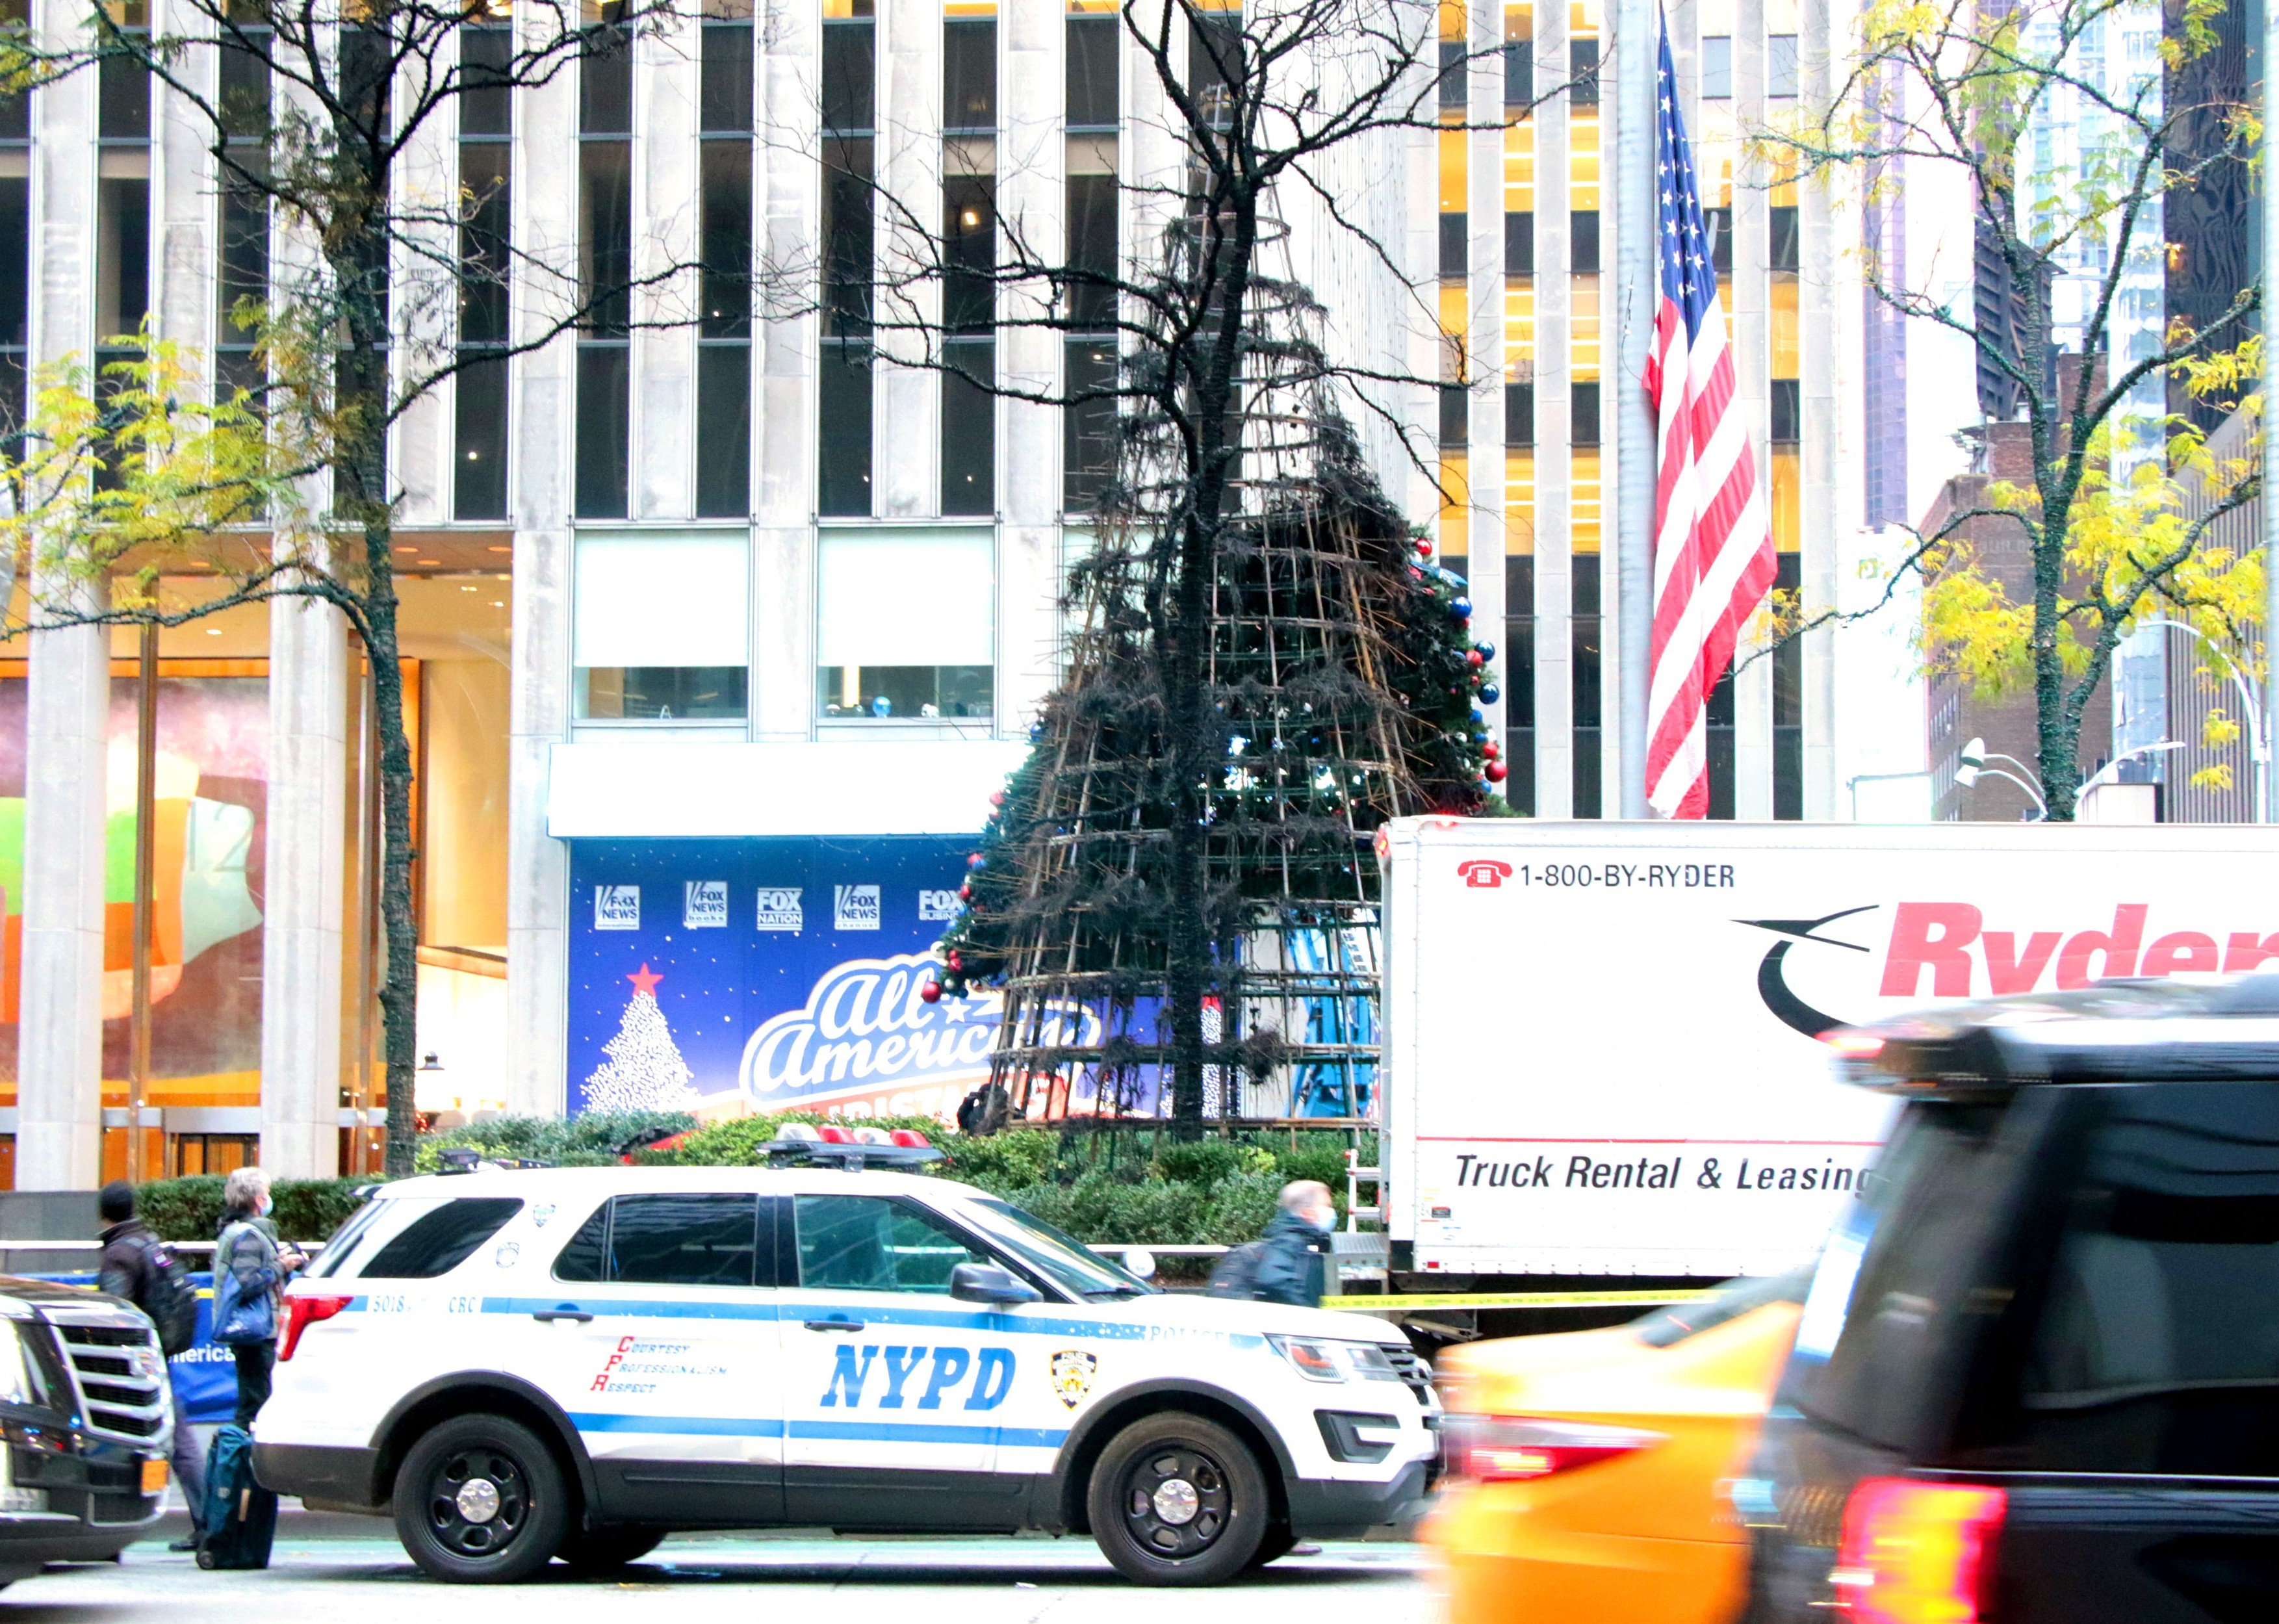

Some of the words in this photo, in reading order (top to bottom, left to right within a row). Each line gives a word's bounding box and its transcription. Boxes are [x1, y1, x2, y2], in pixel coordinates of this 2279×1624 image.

[1521, 865, 1735, 888] 1-800-BY-RYDER
[610, 896, 636, 907] FOX
[700, 891, 724, 901] FOX
[758, 891, 803, 910] FOX
[850, 896, 876, 907] FOX
[919, 890, 966, 910] FOX
[602, 909, 637, 919] NEWS
[693, 903, 725, 912] NEWS
[842, 909, 877, 919] NEWS
[758, 913, 802, 924] NATION
[819, 970, 934, 1039] All
[1456, 1155, 1553, 1187] Truck
[1566, 1157, 1681, 1188] Rental
[1697, 1157, 1721, 1189] &
[1736, 1158, 1873, 1199] Leasing
[617, 1336, 690, 1353] COURTESY
[590, 1374, 656, 1393] RESPECT
[819, 1344, 1016, 1411] NYPD
